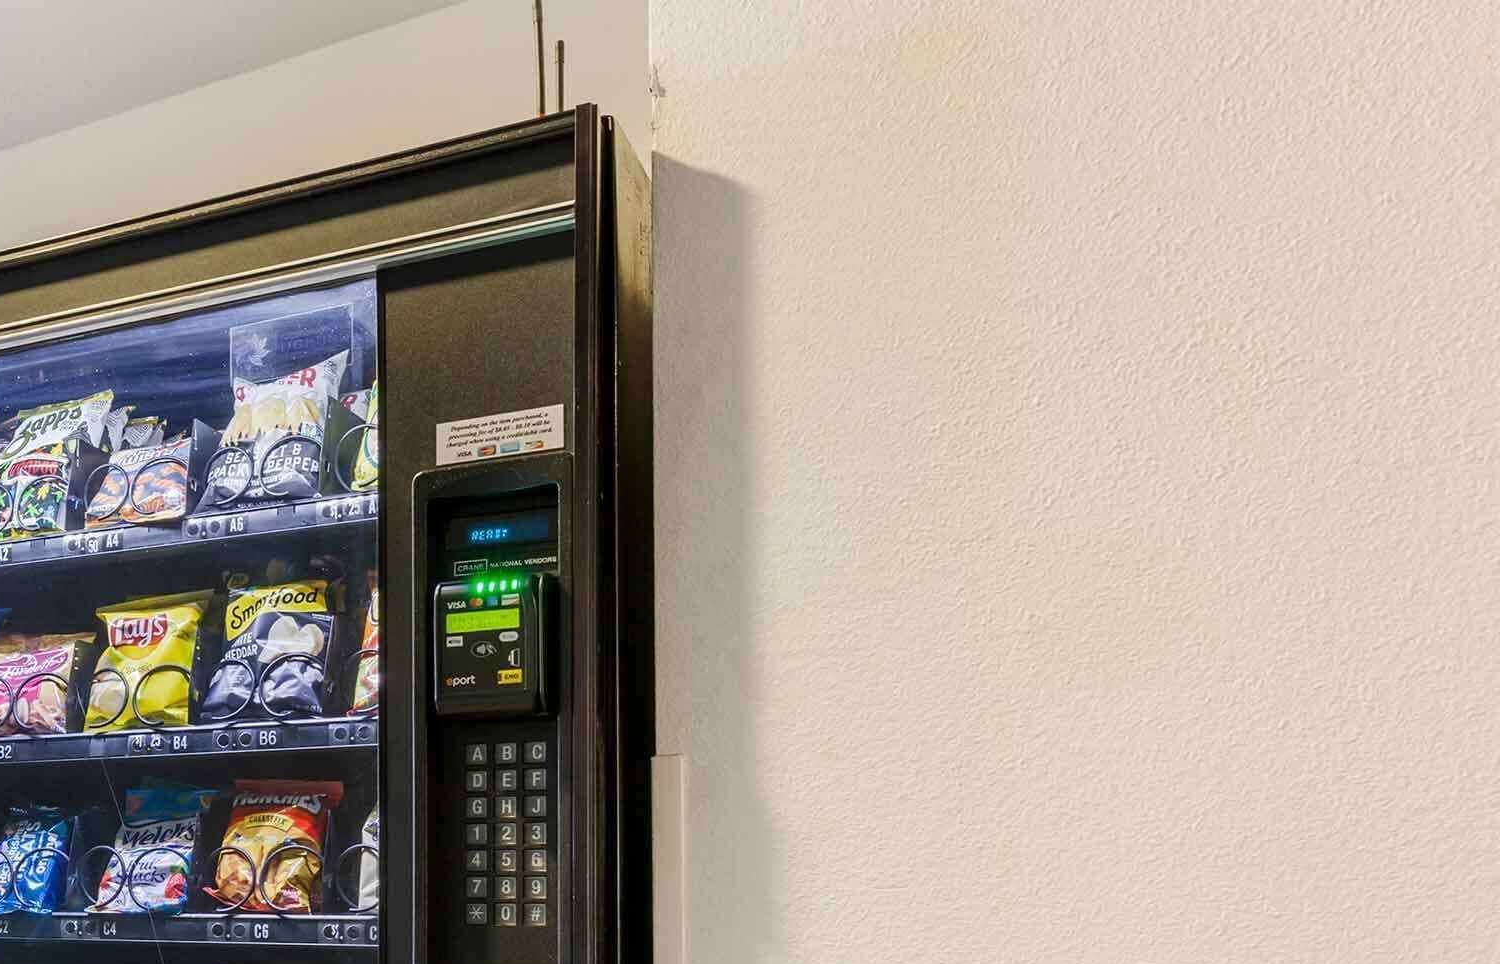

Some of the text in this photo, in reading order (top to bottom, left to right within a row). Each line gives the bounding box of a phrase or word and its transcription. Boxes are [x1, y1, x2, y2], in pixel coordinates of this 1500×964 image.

[456, 450, 472, 458] VISA
[267, 457, 319, 474] PEPPER
[230, 520, 244, 532] A6
[105, 534, 119, 548] A4
[457, 555, 557, 574] CRANE NATIONAL VENDORS
[231, 588, 318, 630] Smartfood
[447, 601, 467, 610] VISA
[446, 674, 476, 688] eport
[173, 736, 187, 750] B4
[259, 731, 277, 746] B6
[473, 744, 543, 760] A B C
[473, 772, 541, 787] D E F
[472, 798, 541, 814] G H J
[473, 826, 541, 840] 1 2 3
[472, 852, 541, 867] 4 5 6
[472, 879, 541, 894] 7 8 9
[103, 922, 116, 936] C4
[254, 924, 269, 939] C6
